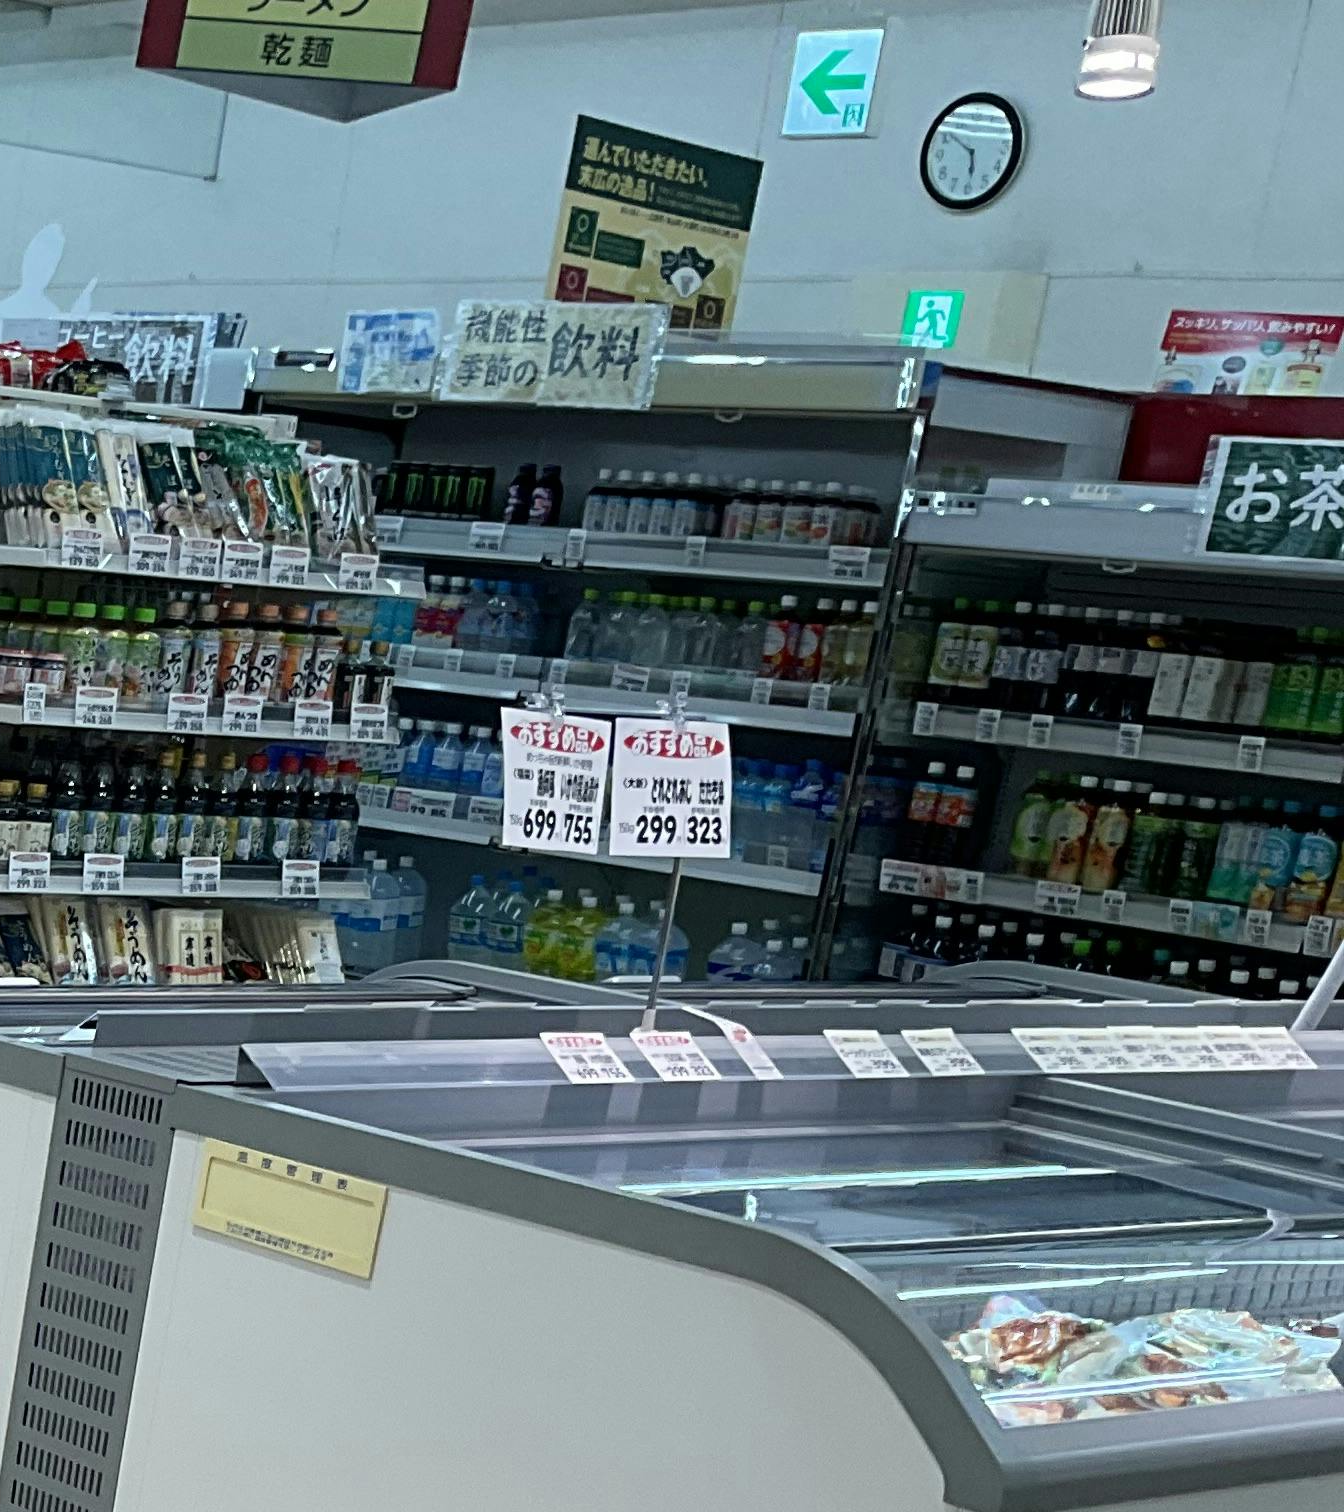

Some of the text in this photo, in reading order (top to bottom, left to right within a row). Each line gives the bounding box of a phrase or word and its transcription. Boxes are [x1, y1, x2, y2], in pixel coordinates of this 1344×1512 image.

[260, 33, 335, 69] 乾麺
[124, 329, 196, 384] 飲料
[456, 352, 539, 388] 季節の
[547, 322, 641, 382] 飲料
[1225, 461, 1344, 532] お茶
[631, 728, 717, 758] おすすめ品!
[523, 808, 557, 841] 699
[564, 813, 593, 845] 755
[636, 814, 677, 845] 299
[686, 815, 722, 845] 323
